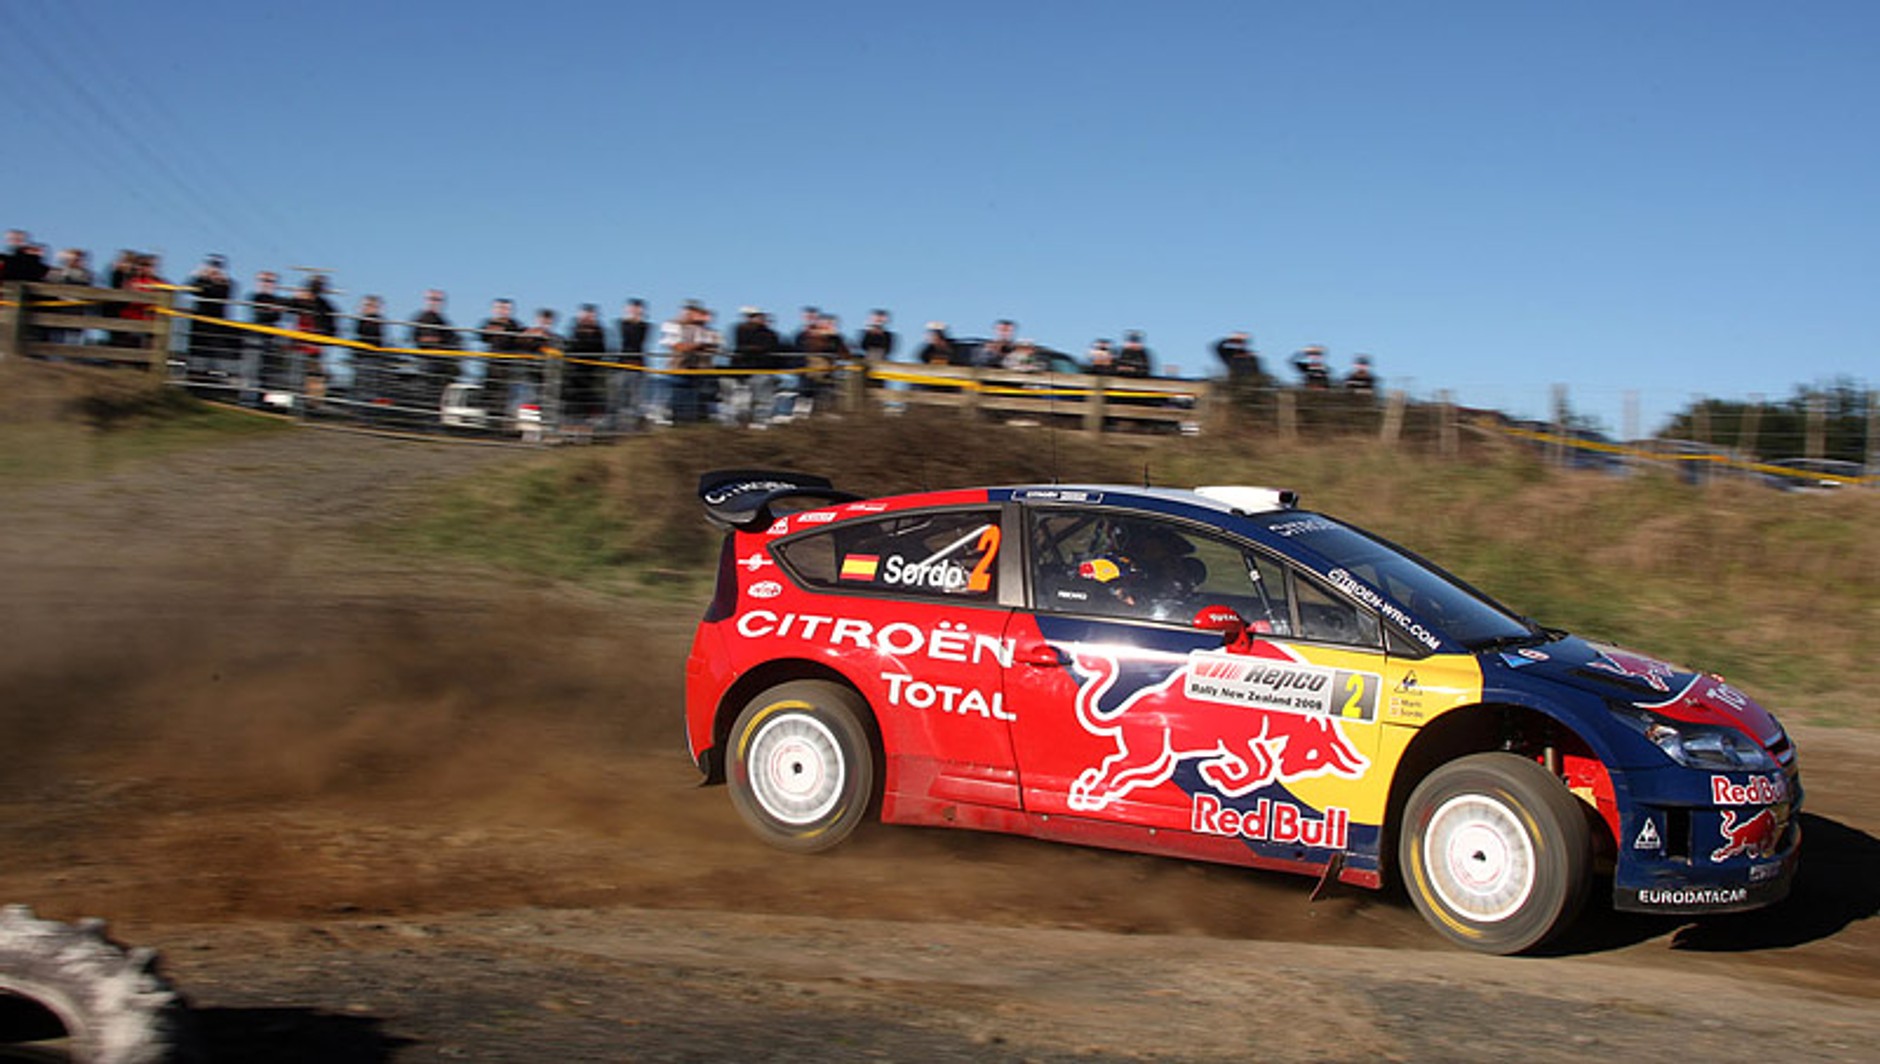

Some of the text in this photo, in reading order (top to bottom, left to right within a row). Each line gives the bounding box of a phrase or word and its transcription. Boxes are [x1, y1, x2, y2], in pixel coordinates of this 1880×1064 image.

[883, 555, 962, 588] Sordo
[967, 524, 1001, 591] 2
[737, 610, 1017, 668] CITROËN
[880, 672, 1017, 721] TOTAL
[1191, 683, 1323, 711] Rally New Zealand 2008
[1341, 673, 1365, 719] 2
[1711, 775, 1760, 805] Red
[1192, 792, 1349, 849] Red Bull
